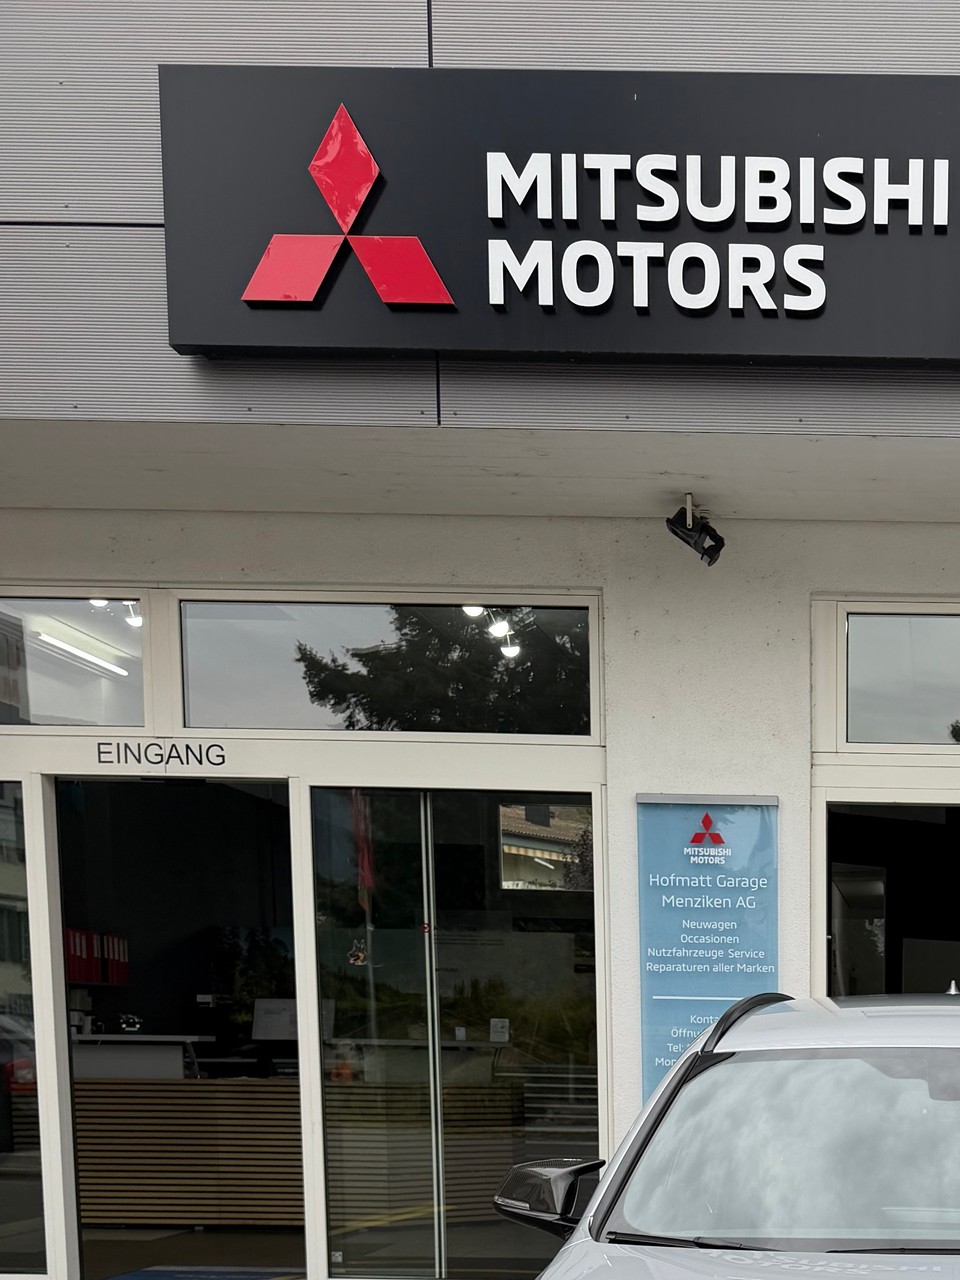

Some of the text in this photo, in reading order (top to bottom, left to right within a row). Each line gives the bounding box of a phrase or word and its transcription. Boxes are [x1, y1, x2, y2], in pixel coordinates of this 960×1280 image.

[486, 152, 949, 227] MITSUBISHI
[487, 239, 827, 312] MOTORS
[97, 742, 226, 766] EINGANG
[683, 847, 732, 856] MITSUBISHI
[690, 857, 726, 865] MOTORS
[649, 873, 768, 891] Hofmatt Garage
[662, 895, 756, 909] Menziken AG
[682, 919, 737, 931] Neuwagen
[680, 934, 740, 944] Occasionen
[647, 947, 765, 960] Nutzfahrzeuge Service
[646, 962, 775, 974] Reparaturen aller Marken
[667, 1043, 684, 1053] Tel:
